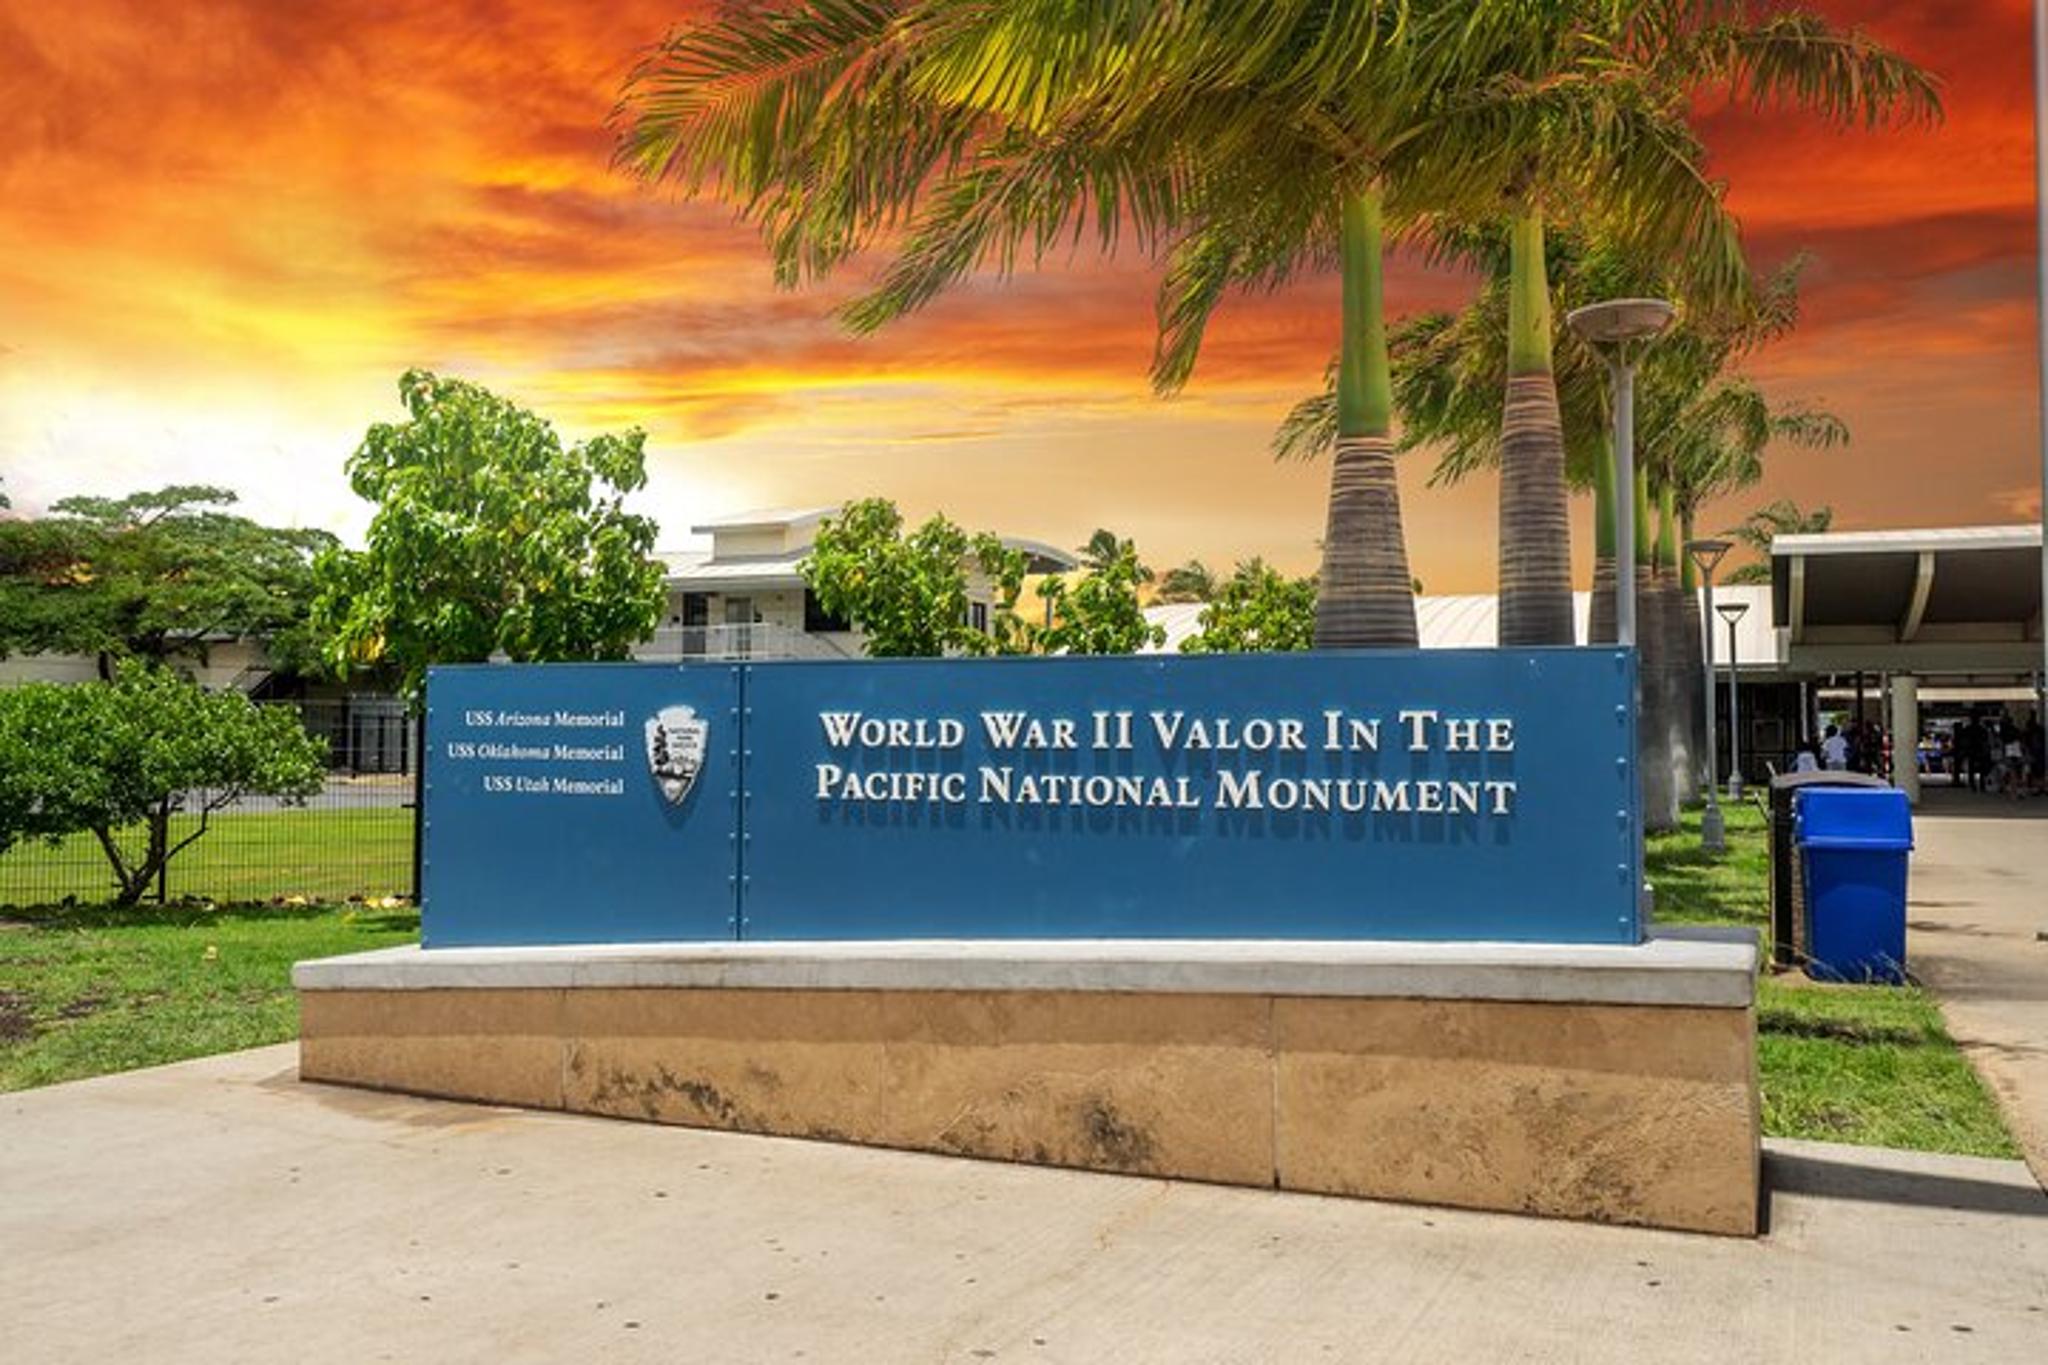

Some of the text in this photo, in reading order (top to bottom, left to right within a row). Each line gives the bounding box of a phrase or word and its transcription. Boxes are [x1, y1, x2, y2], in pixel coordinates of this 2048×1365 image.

[465, 710, 625, 728] USS Arizona Memorial
[819, 710, 1515, 752] WORLD WAR II VALOR IN THE
[448, 742, 625, 761] USS Oklahoma Memorial
[483, 775, 625, 795] USS Utah Memorial
[815, 763, 1517, 814] PACIFIC NATIONAL MONUMENT
